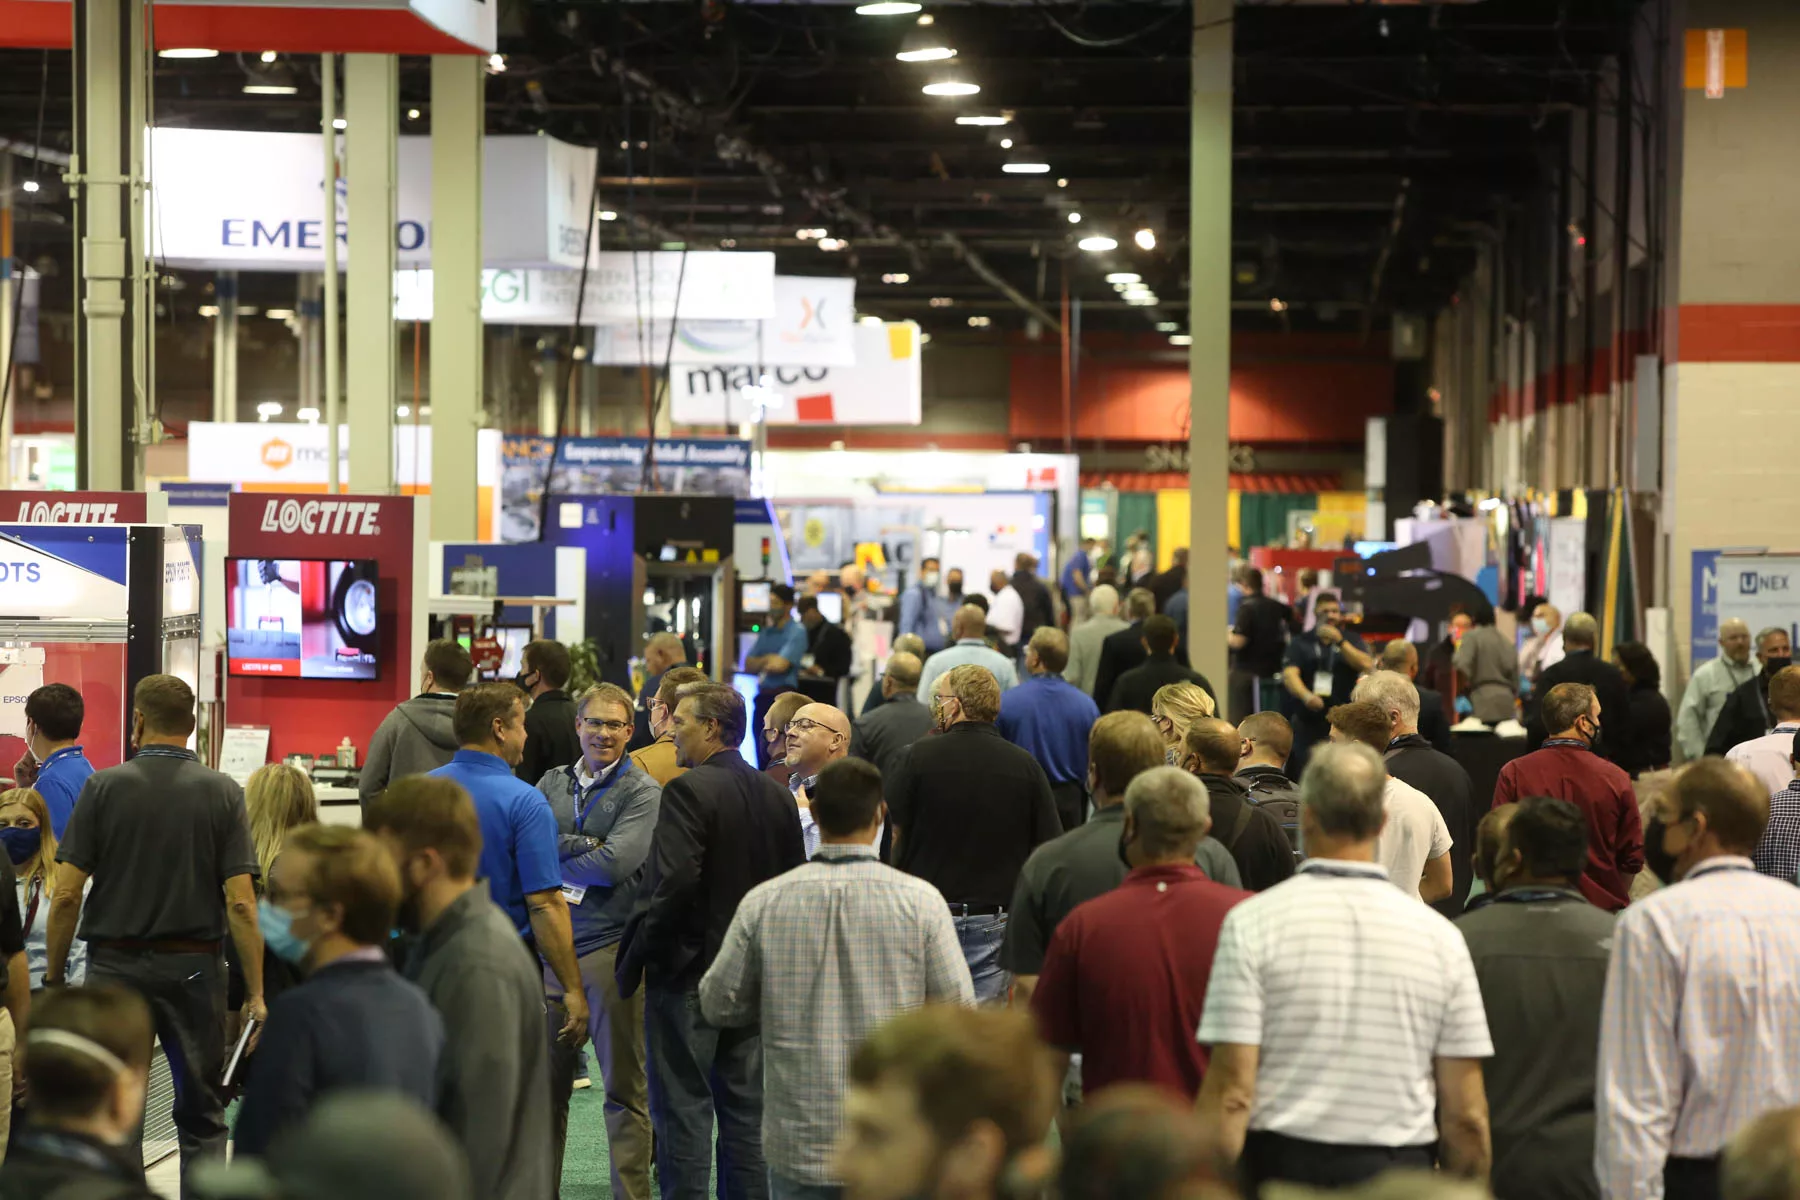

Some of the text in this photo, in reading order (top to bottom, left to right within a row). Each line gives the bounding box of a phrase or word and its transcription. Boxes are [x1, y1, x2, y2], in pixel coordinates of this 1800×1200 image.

[222, 219, 432, 251] EMERO
[687, 364, 829, 395] maco
[260, 499, 381, 535] LOCTITE
[1740, 572, 1789, 594] UNEX
[3, 696, 31, 704] EPSO
